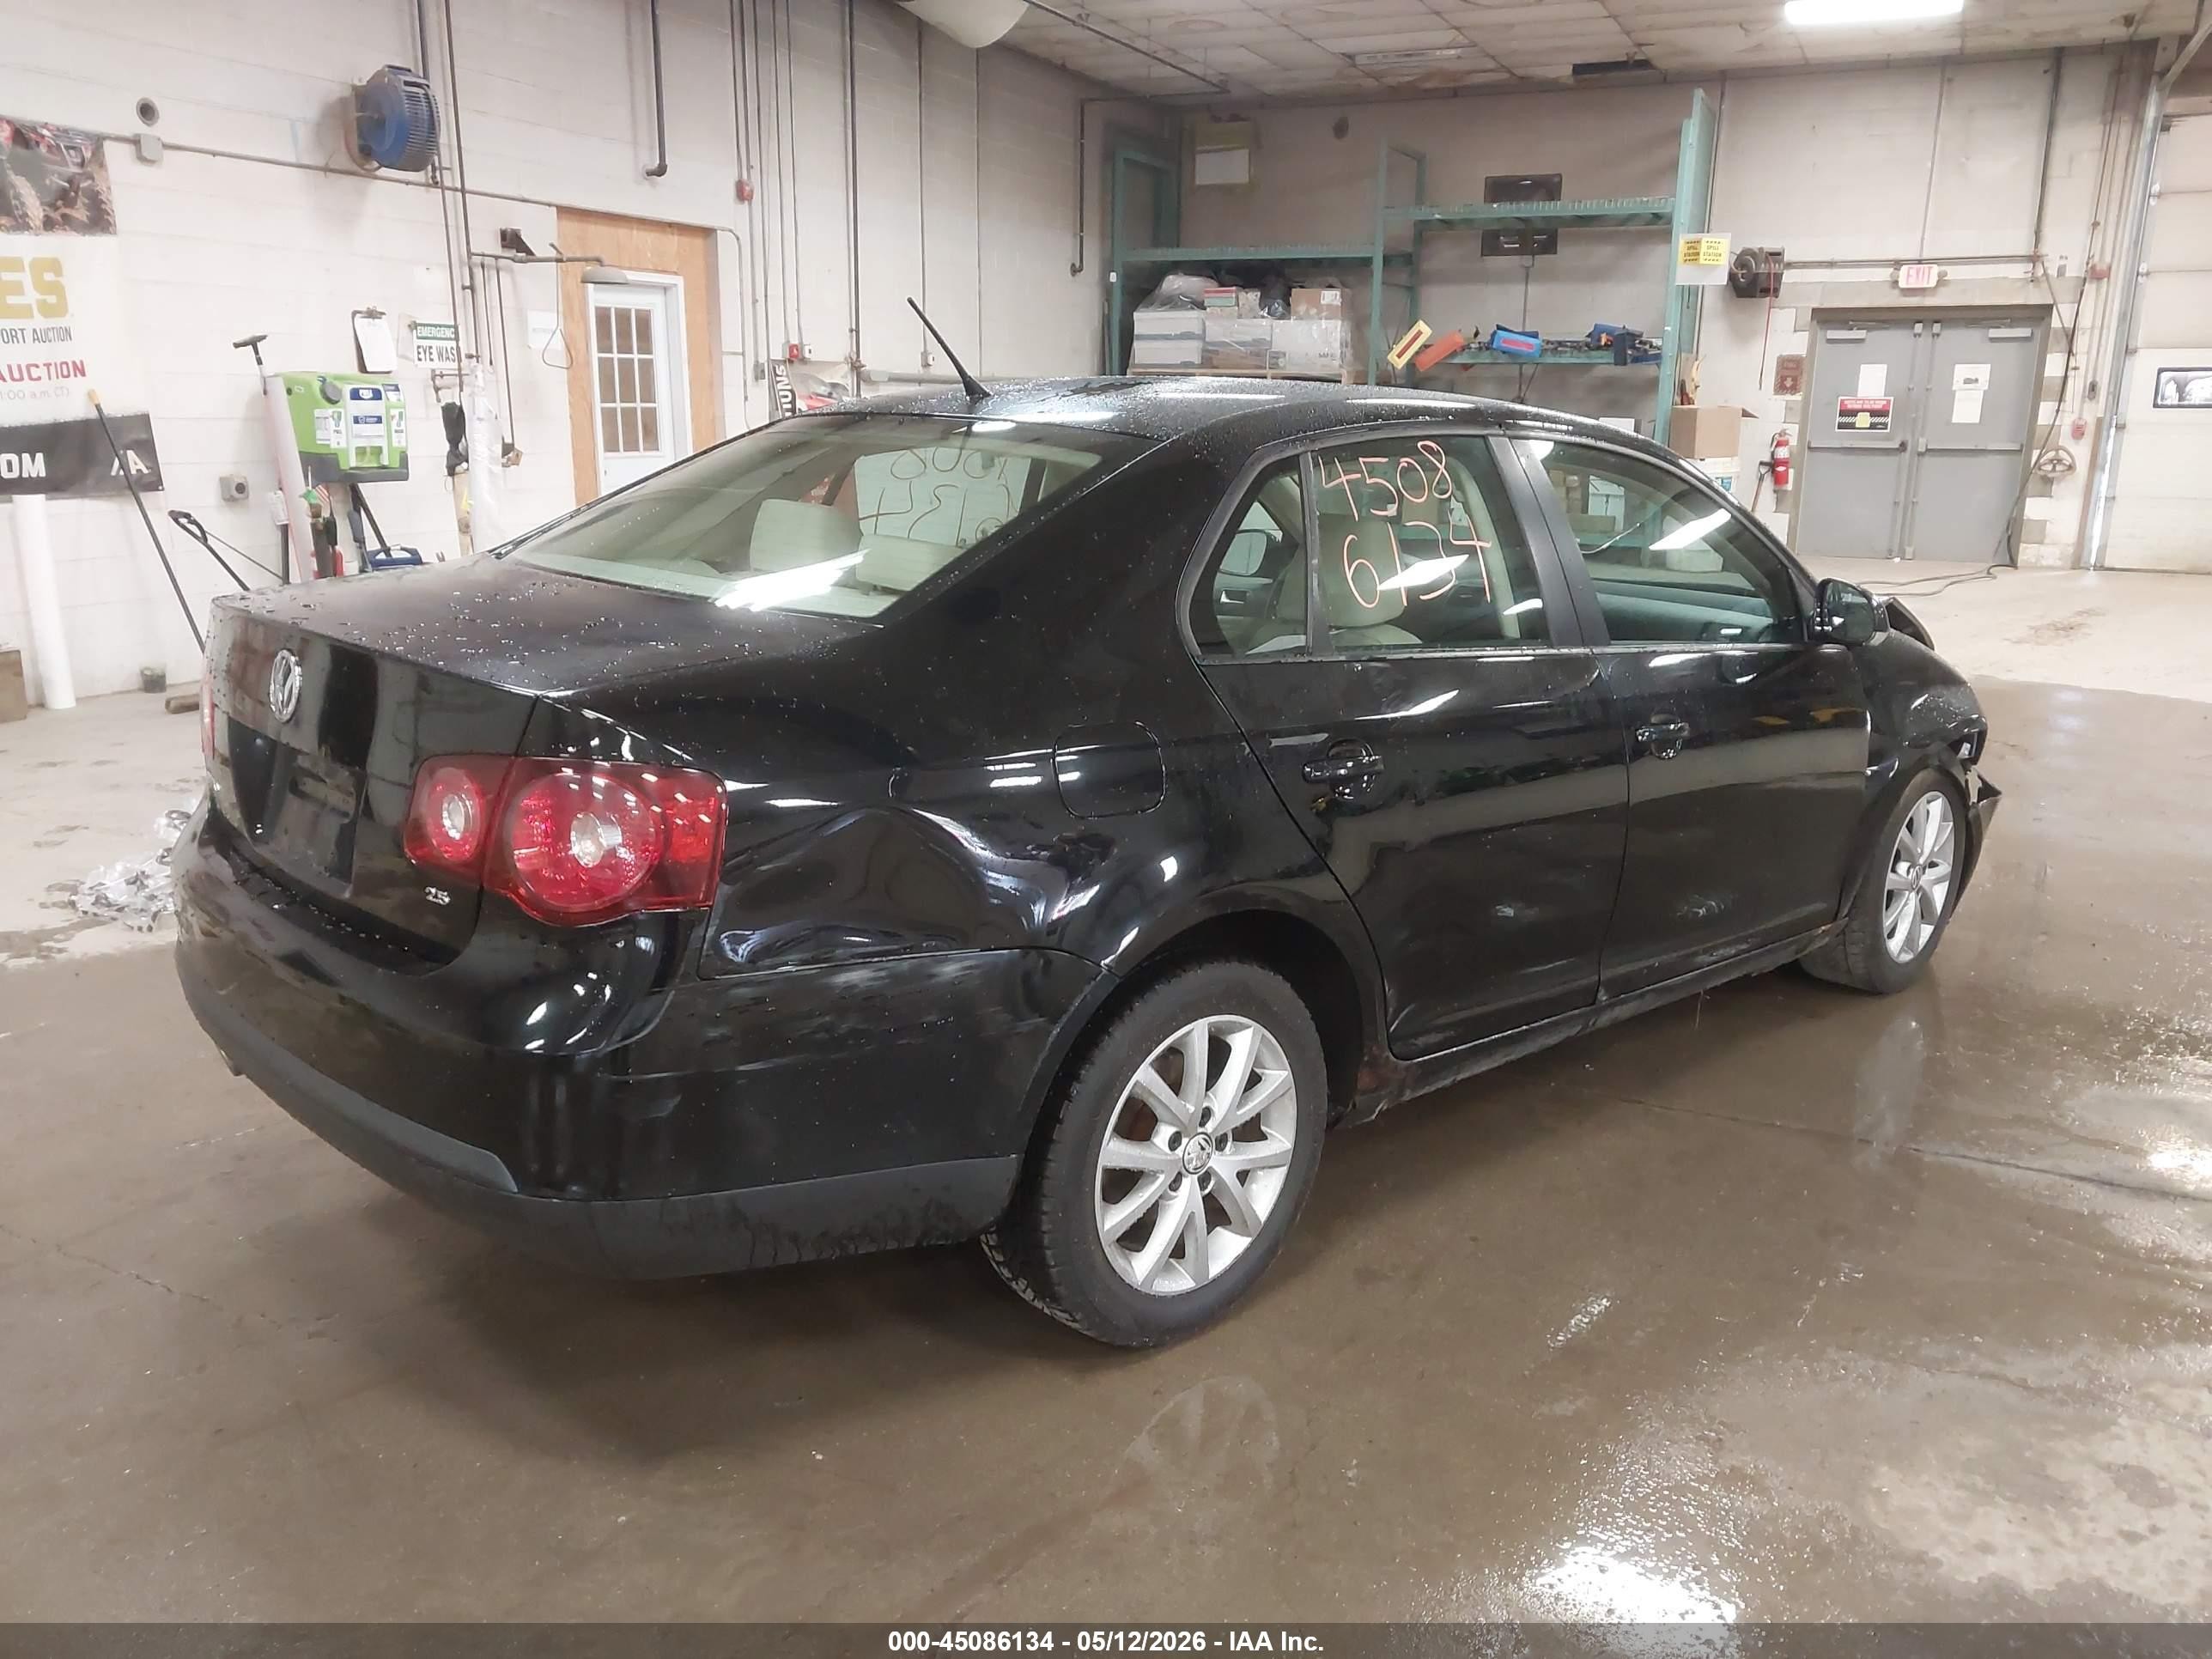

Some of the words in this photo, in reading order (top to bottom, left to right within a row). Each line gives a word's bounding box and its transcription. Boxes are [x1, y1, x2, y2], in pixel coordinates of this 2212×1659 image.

[1905, 265, 1934, 285] EXIT
[0, 327, 27, 344] ORT
[32, 325, 72, 344] AUCTION
[416, 325, 456, 338] EMERGENC
[416, 344, 434, 362] EYE
[435, 345, 457, 363] WAS
[0, 452, 46, 479] OM
[1318, 441, 1452, 522] 4508
